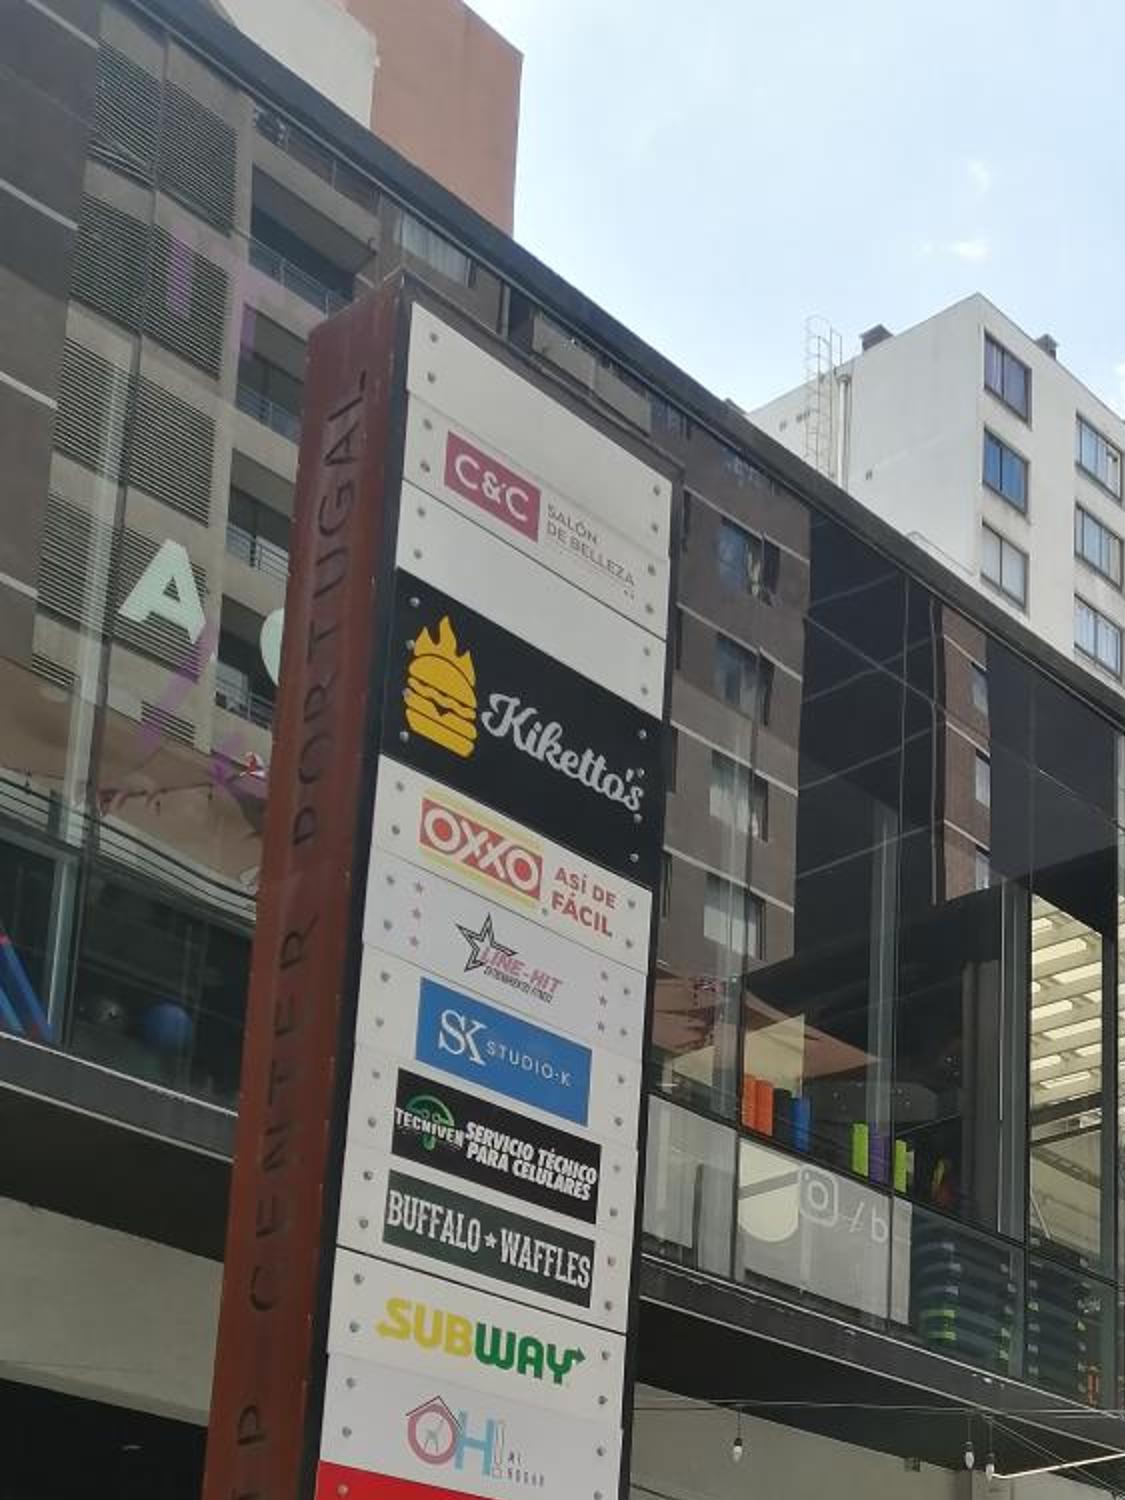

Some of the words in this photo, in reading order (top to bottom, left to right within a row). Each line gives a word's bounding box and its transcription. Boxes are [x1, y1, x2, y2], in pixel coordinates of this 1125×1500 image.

[455, 453, 529, 522] C&C
[546, 521, 567, 543] DE
[569, 539, 636, 586] BELLEZA
[547, 502, 598, 545] SALÓN
[422, 806, 540, 896] OXXO
[551, 889, 614, 938] FÁCIL
[592, 880, 617, 909] DE
[438, 1009, 487, 1067] SK
[395, 1107, 466, 1148] TECNIVEN
[465, 1121, 535, 1160] SERVICIO
[537, 1146, 598, 1185] TÉCNICO
[466, 1141, 509, 1173] PARA
[511, 1159, 591, 1201] CELULARES
[387, 1189, 481, 1254] BUFFALO
[500, 1228, 591, 1289] WAFFLES
[376, 1297, 587, 1386] SUBWAY
